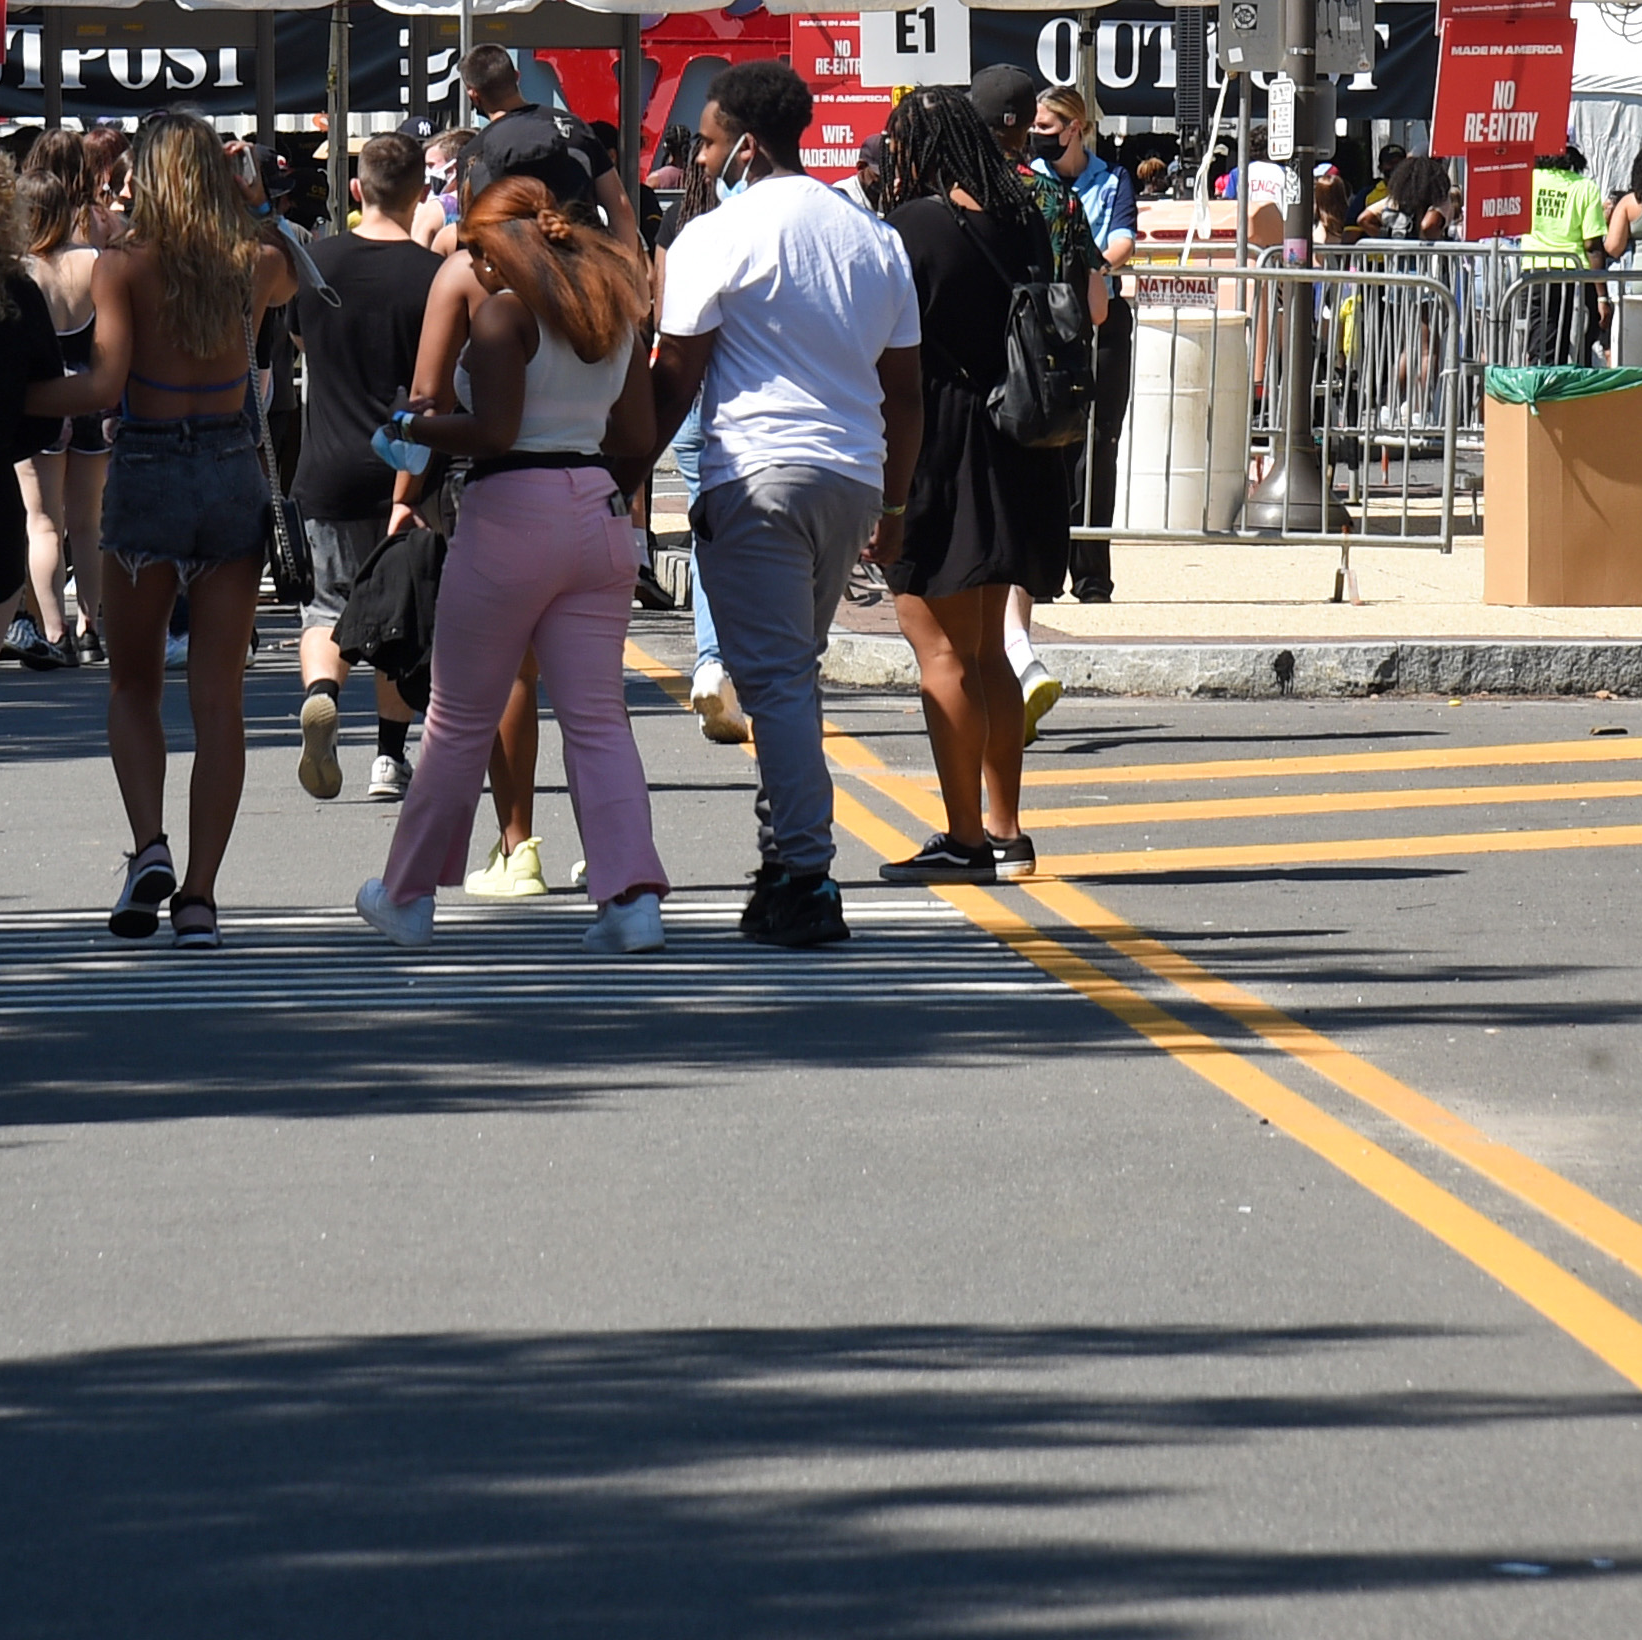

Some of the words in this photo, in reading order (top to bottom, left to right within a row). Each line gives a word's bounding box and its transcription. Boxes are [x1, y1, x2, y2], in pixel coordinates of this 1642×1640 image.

[895, 6, 935, 54] E1
[834, 40, 851, 58] NO
[1451, 46, 1489, 56] MADE
[1490, 46, 1504, 55] IN
[1505, 44, 1563, 55] AMERICA
[815, 58, 861, 76] RE-ENTR
[835, 94, 891, 103] AMERICA
[1493, 80, 1516, 110] NO
[821, 126, 854, 144] WIFI:
[1464, 112, 1539, 143] RE-ENTRY
[1482, 198, 1495, 218] NO
[1496, 196, 1521, 216] BAGS
[1537, 197, 1565, 208] EVENT
[1138, 279, 1215, 294] NATIONAL
